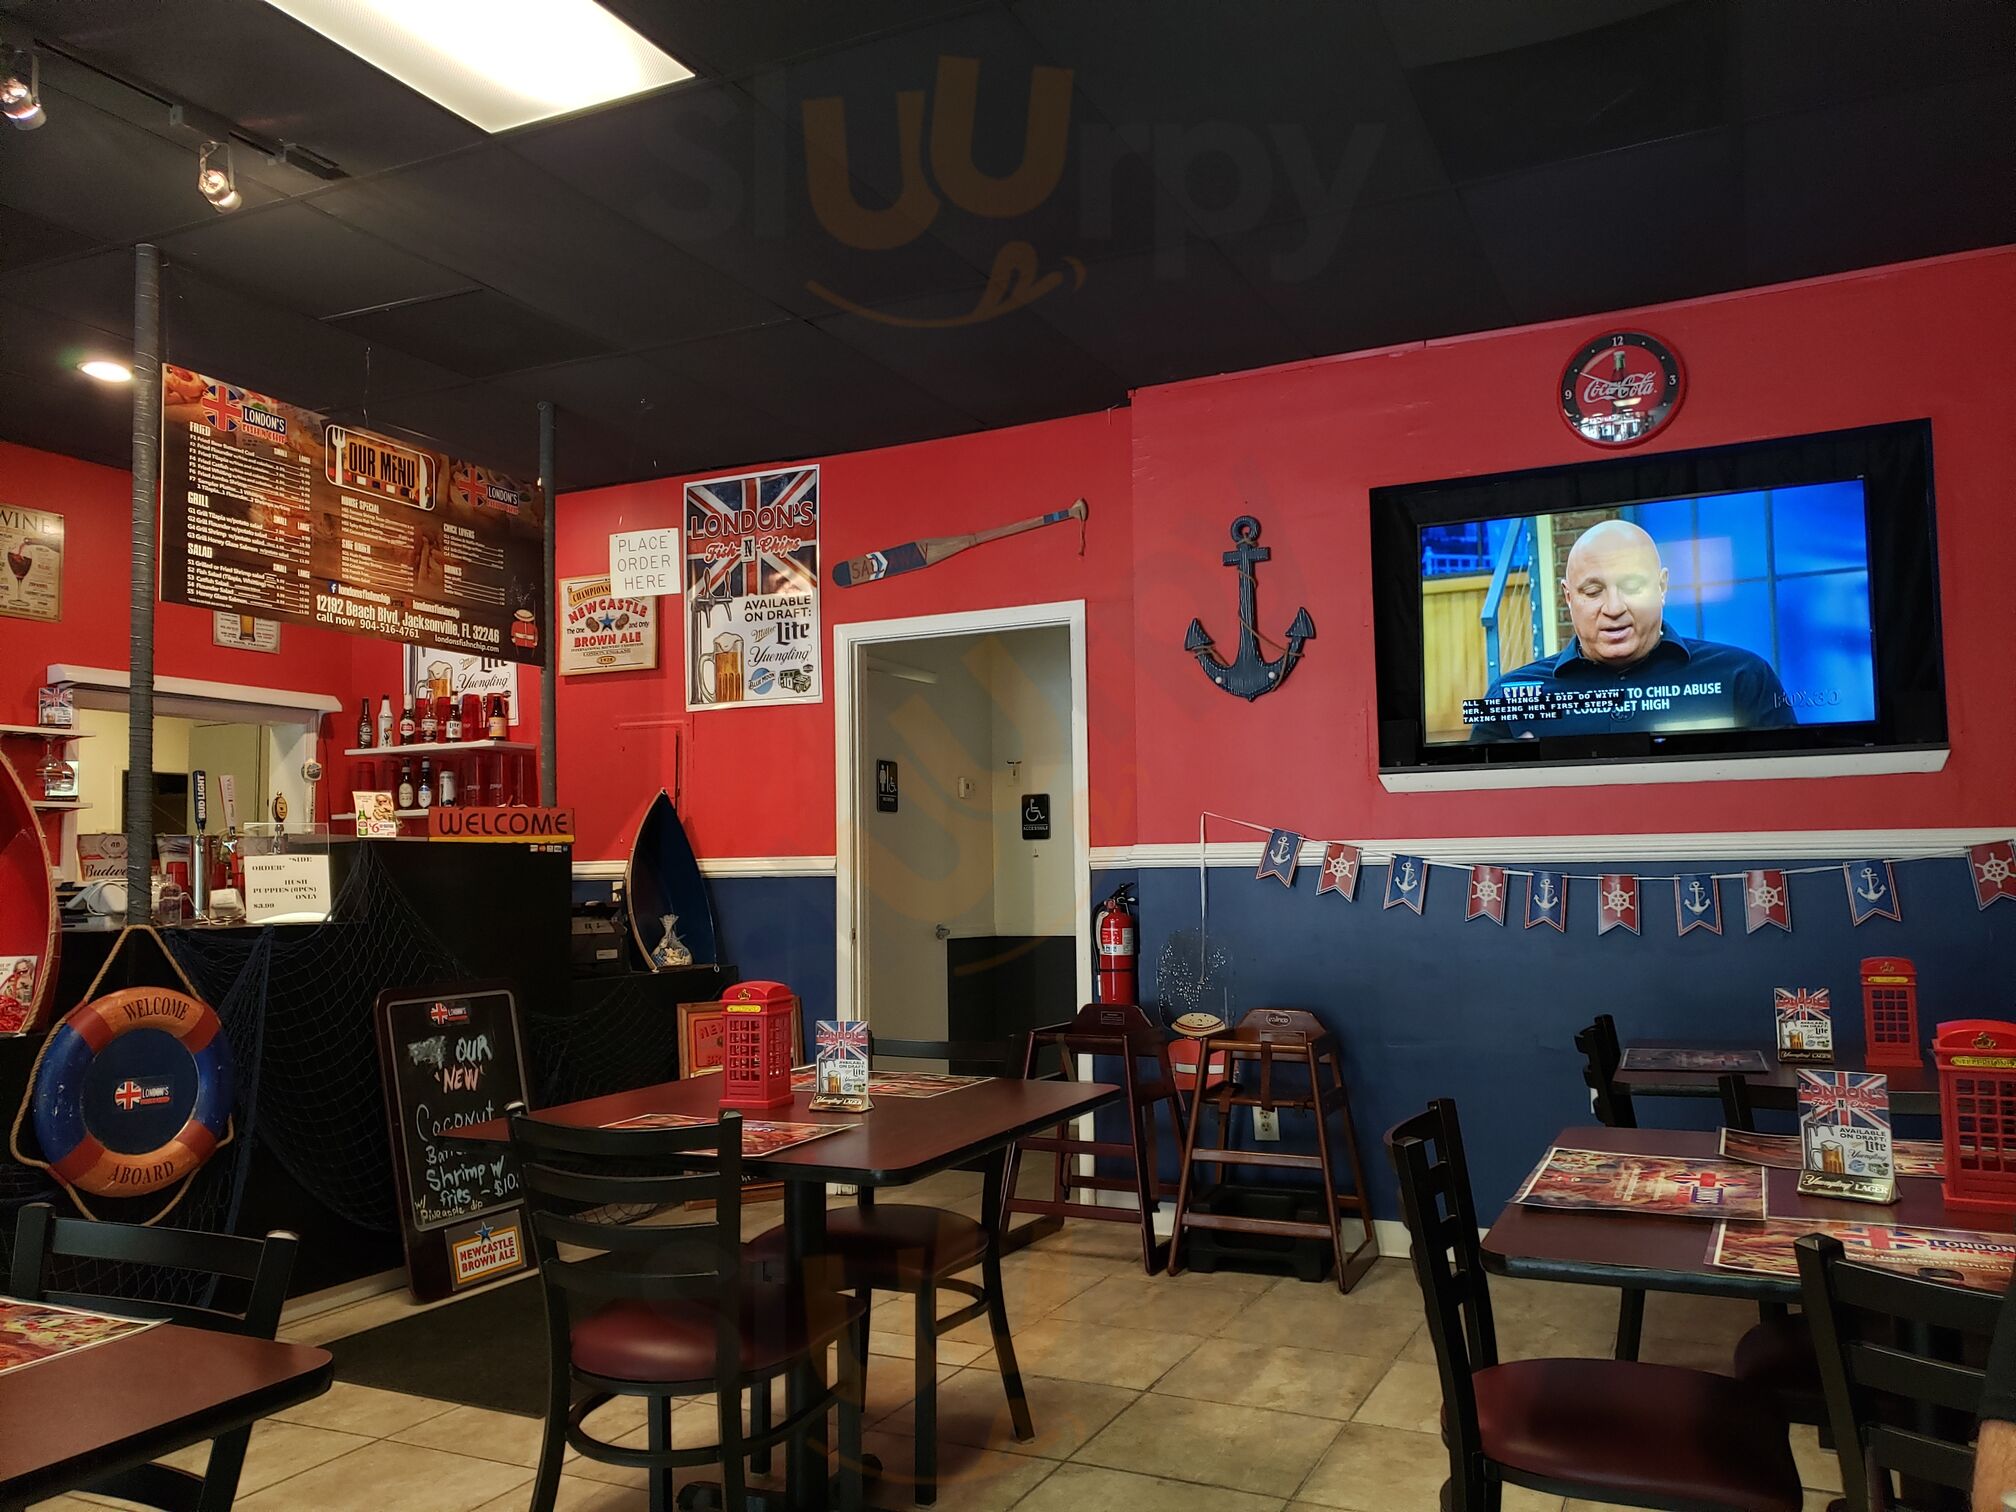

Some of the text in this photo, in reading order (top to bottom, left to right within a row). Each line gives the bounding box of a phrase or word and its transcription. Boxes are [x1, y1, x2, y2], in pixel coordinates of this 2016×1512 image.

[1612, 336, 1624, 346] 12
[1669, 375, 1676, 385] 3
[1564, 390, 1572, 400] 9
[244, 407, 286, 433] LONDON'S
[190, 421, 210, 436] FRIED
[197, 442, 209, 450] Fried
[197, 449, 228, 463] Fried Tilapia
[197, 457, 210, 465] Fried
[197, 463, 210, 471] Fried
[197, 469, 210, 478] Fried
[349, 441, 416, 490] OUR MENU
[188, 491, 209, 508] GRILL
[488, 486, 518, 505] LONDON'S
[196, 509, 207, 517] Grill
[209, 512, 225, 522] Tilapia
[690, 501, 814, 540] LONDON'S
[196, 525, 207, 533] Grill
[208, 528, 226, 538] Shrimp
[208, 520, 230, 530] Flounder
[195, 533, 207, 541] Grill
[207, 536, 224, 546] Honey
[618, 535, 668, 552] PLACE
[188, 542, 213, 558] SALAD
[195, 560, 213, 569] Grilled
[220, 565, 232, 573] Fried
[617, 554, 671, 572] ORDER
[208, 570, 221, 578] Salad
[624, 573, 667, 590] HERE
[568, 598, 648, 624] NEWCASTLE
[744, 595, 811, 611] AVAILABLE
[346, 600, 375, 621] Beach
[377, 606, 400, 626] Blvd,
[402, 612, 460, 637] Jacksonville,
[462, 622, 471, 639] FL
[472, 626, 500, 644] 32246
[745, 607, 811, 622] ON DRAFT:
[316, 612, 419, 639] call now 904-516-4761
[751, 621, 810, 646] Miller Lite
[574, 632, 641, 648] BROWN ALE
[748, 644, 812, 667] Yuengling
[457, 672, 511, 693] Yuengling
[1627, 683, 1722, 699] TO CHILD ABUSE
[1506, 696, 1539, 704] THINGS
[1642, 698, 1670, 711] HIGH
[1490, 706, 1523, 714] SEEING
[1550, 703, 1578, 711] FIRST
[440, 813, 568, 835] WELCOME
[123, 996, 190, 1021] WELCOME
[455, 1034, 493, 1066] OUR
[1800, 1083, 1888, 1100] LONDON'S
[1840, 1127, 1886, 1136] AVAILABLE
[1865, 1140, 1887, 1153] Lite
[108, 1161, 174, 1184] ABOARD
[426, 1164, 486, 1192] Shrimp
[1802, 1175, 1888, 1194] Yuengling LAGER
[440, 1189, 471, 1208] fries
[470, 1200, 484, 1212] dip
[459, 1236, 514, 1261] NEWCASTLE
[462, 1248, 516, 1273] BROWN ALE
